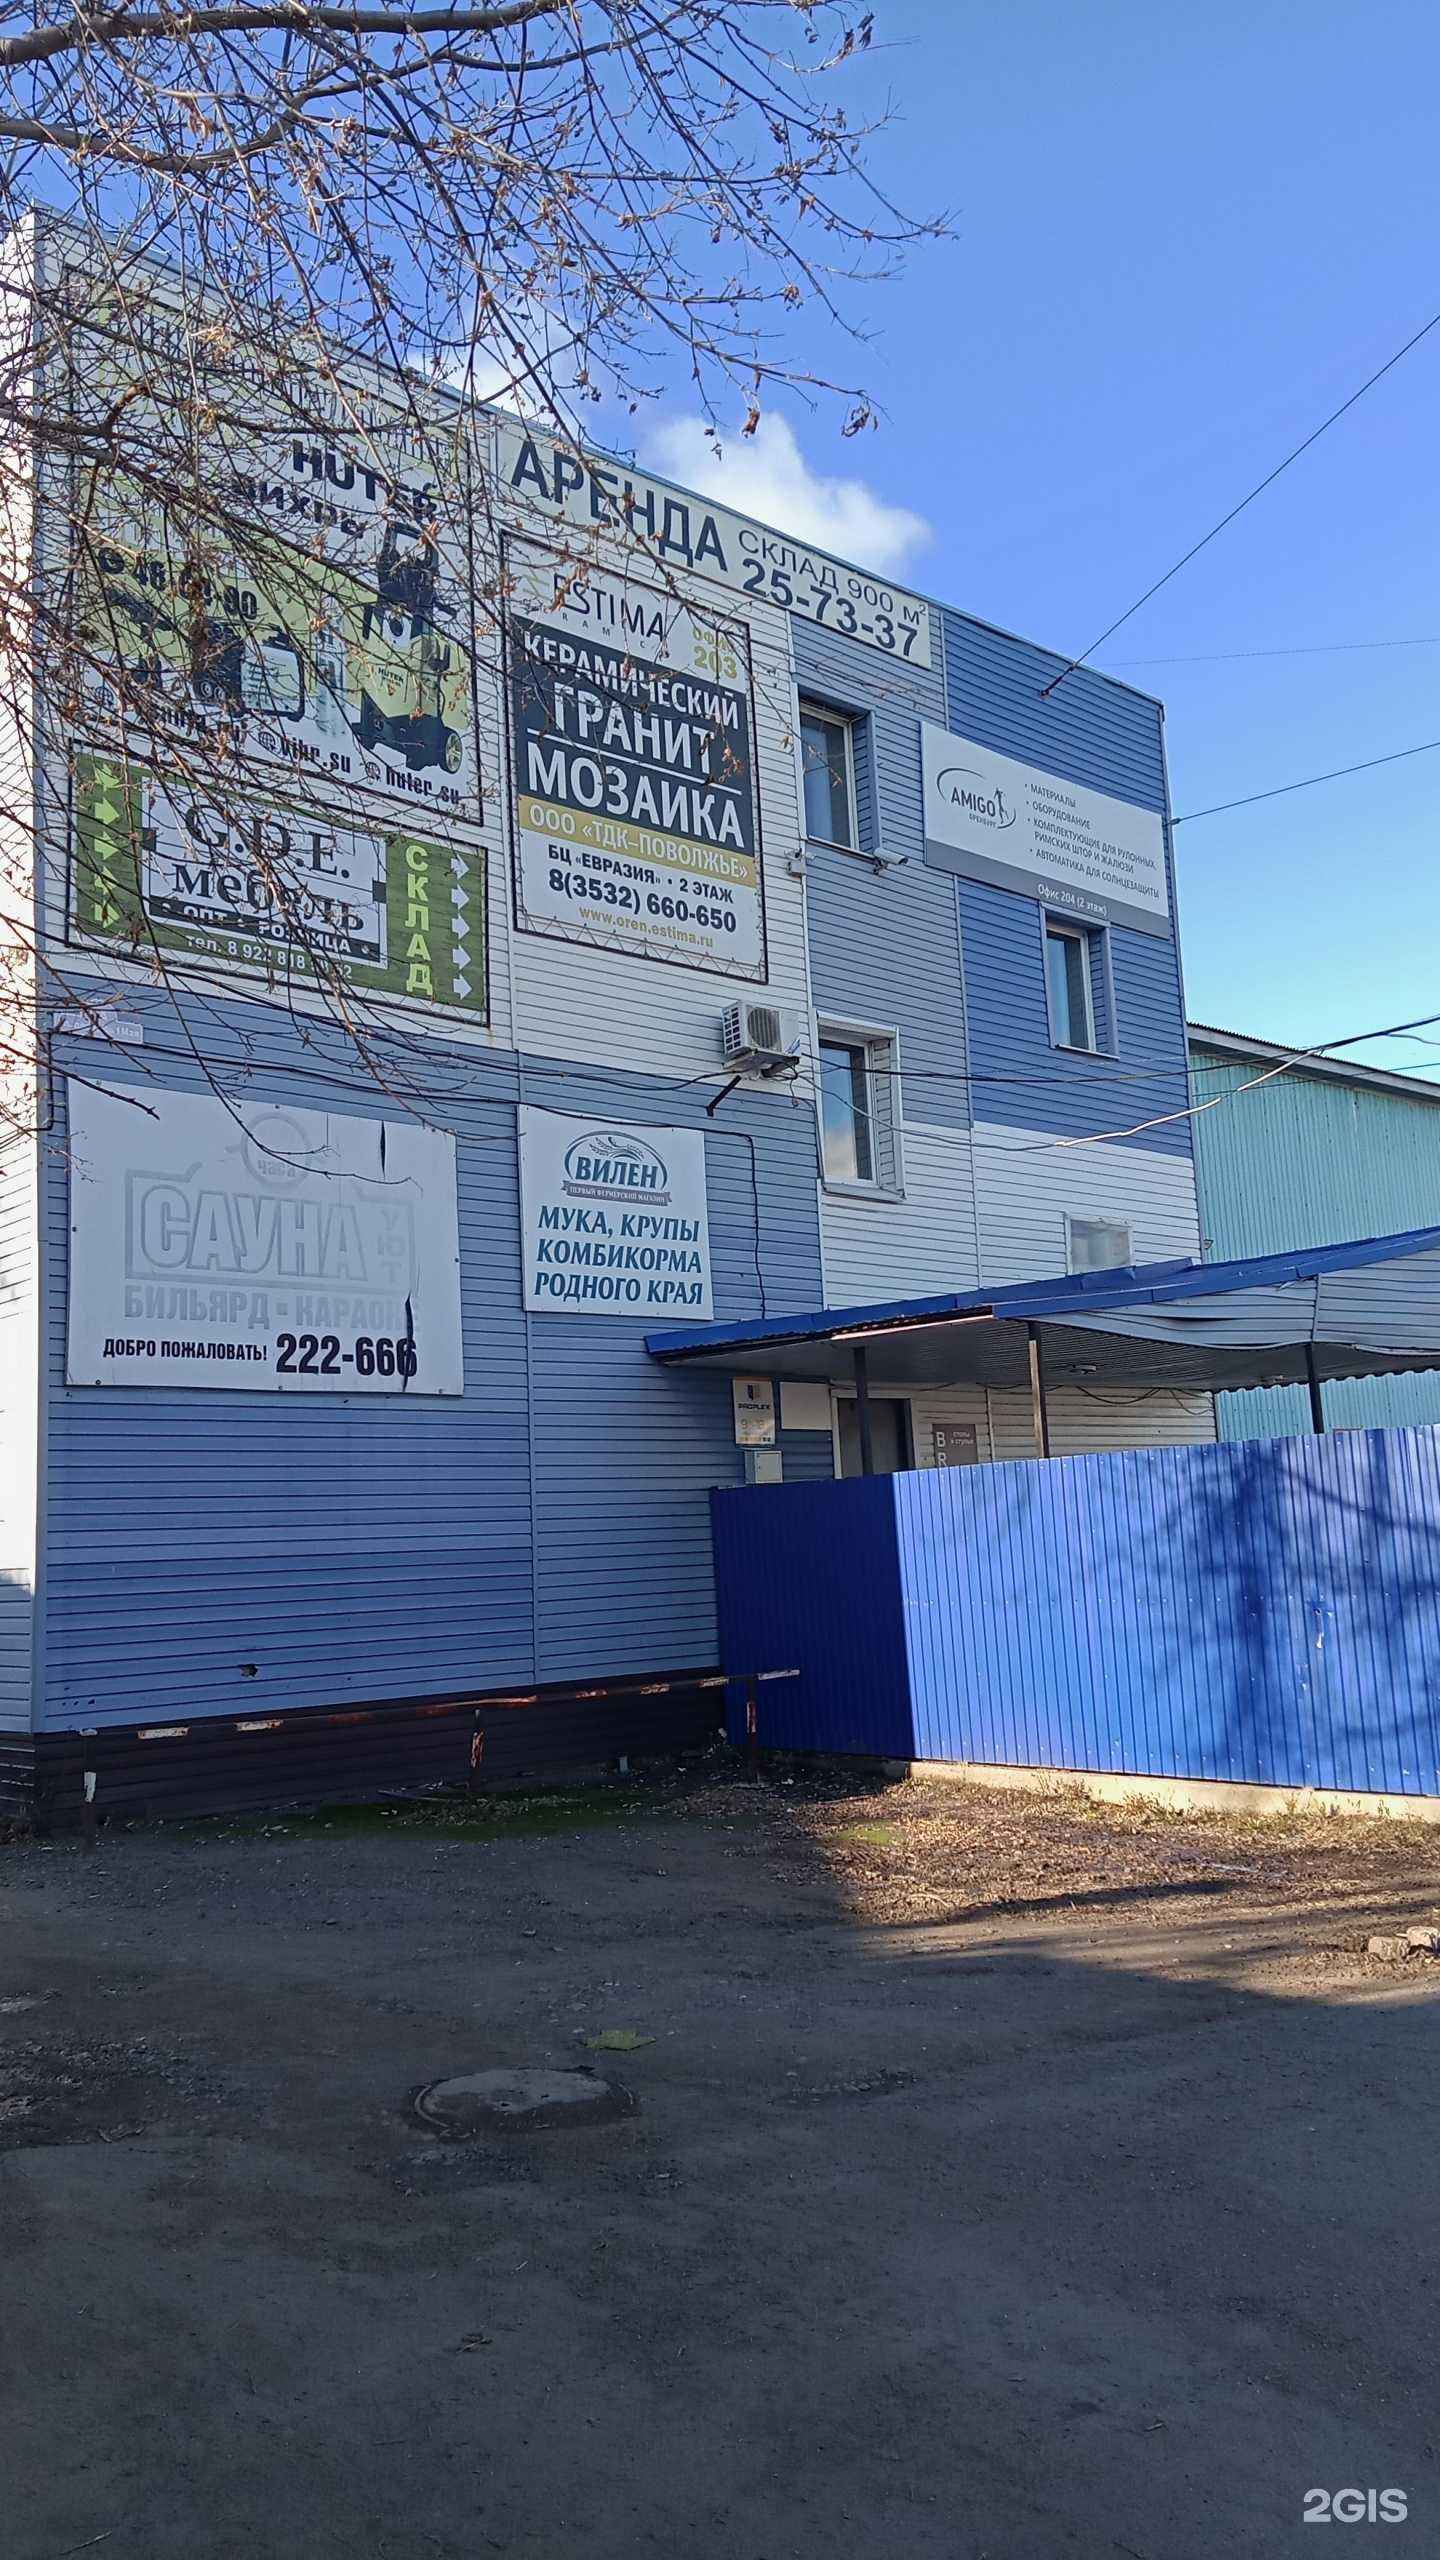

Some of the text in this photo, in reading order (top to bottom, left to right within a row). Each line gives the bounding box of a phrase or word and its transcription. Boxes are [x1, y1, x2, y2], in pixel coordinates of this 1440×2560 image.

[511, 440, 728, 573] АРЕНДА
[738, 529, 840, 595] СКЛАД
[847, 578, 894, 613] 900
[553, 573, 664, 642] ESTIMA
[742, 558, 918, 657] 25-73-37
[525, 630, 739, 730] КЕРАМИЧЕСКИЙ
[694, 645, 738, 679] 203
[553, 682, 715, 774] ГРАНИТ
[527, 741, 745, 849] МОЗАИКА
[950, 786, 996, 817] AMIGO
[1031, 784, 1076, 808] МАТЕРИАЛЫ
[1032, 800, 1091, 830] ОБОРУДОВАНИЕ
[530, 805, 576, 836] ООО
[1033, 818, 1100, 850] КОМПЛЕКТУЮЩИЕ
[1102, 843, 1117, 856] ДЛЯ
[548, 844, 734, 903] БЦ «ЕВРАЗИЯ» 2 ЭТАЖ
[1034, 831, 1134, 874] РИМСКИХ ШТОР И ЖАЛЮЗИ
[1036, 848, 1160, 900] АВТОМАТИКА ДЛЯ СОЛНЦЕЗАЩИТЫ
[172, 863, 365, 931] Мебль
[549, 868, 737, 933] 8(3532) 660-650
[1038, 883, 1060, 899] Офис
[258, 920, 352, 953] РОЗИЦА
[405, 845, 433, 996] СКЛАД
[579, 905, 714, 948] www.oren.estima.ru
[228, 941, 237, 956] 8
[575, 1156, 658, 1189] ВИЛЕН
[141, 1184, 368, 1281] САУНА
[538, 1205, 699, 1242] МУКА, КРУПЫ
[536, 1238, 702, 1273] КОМБИКОРМА
[125, 1284, 270, 1329] БИЛЬЯРД
[534, 1271, 703, 1305] РОДНОГО КРАЯ
[103, 1333, 417, 1377] ДОБРО ПОЖАЛОВАТЬ! 222-666
